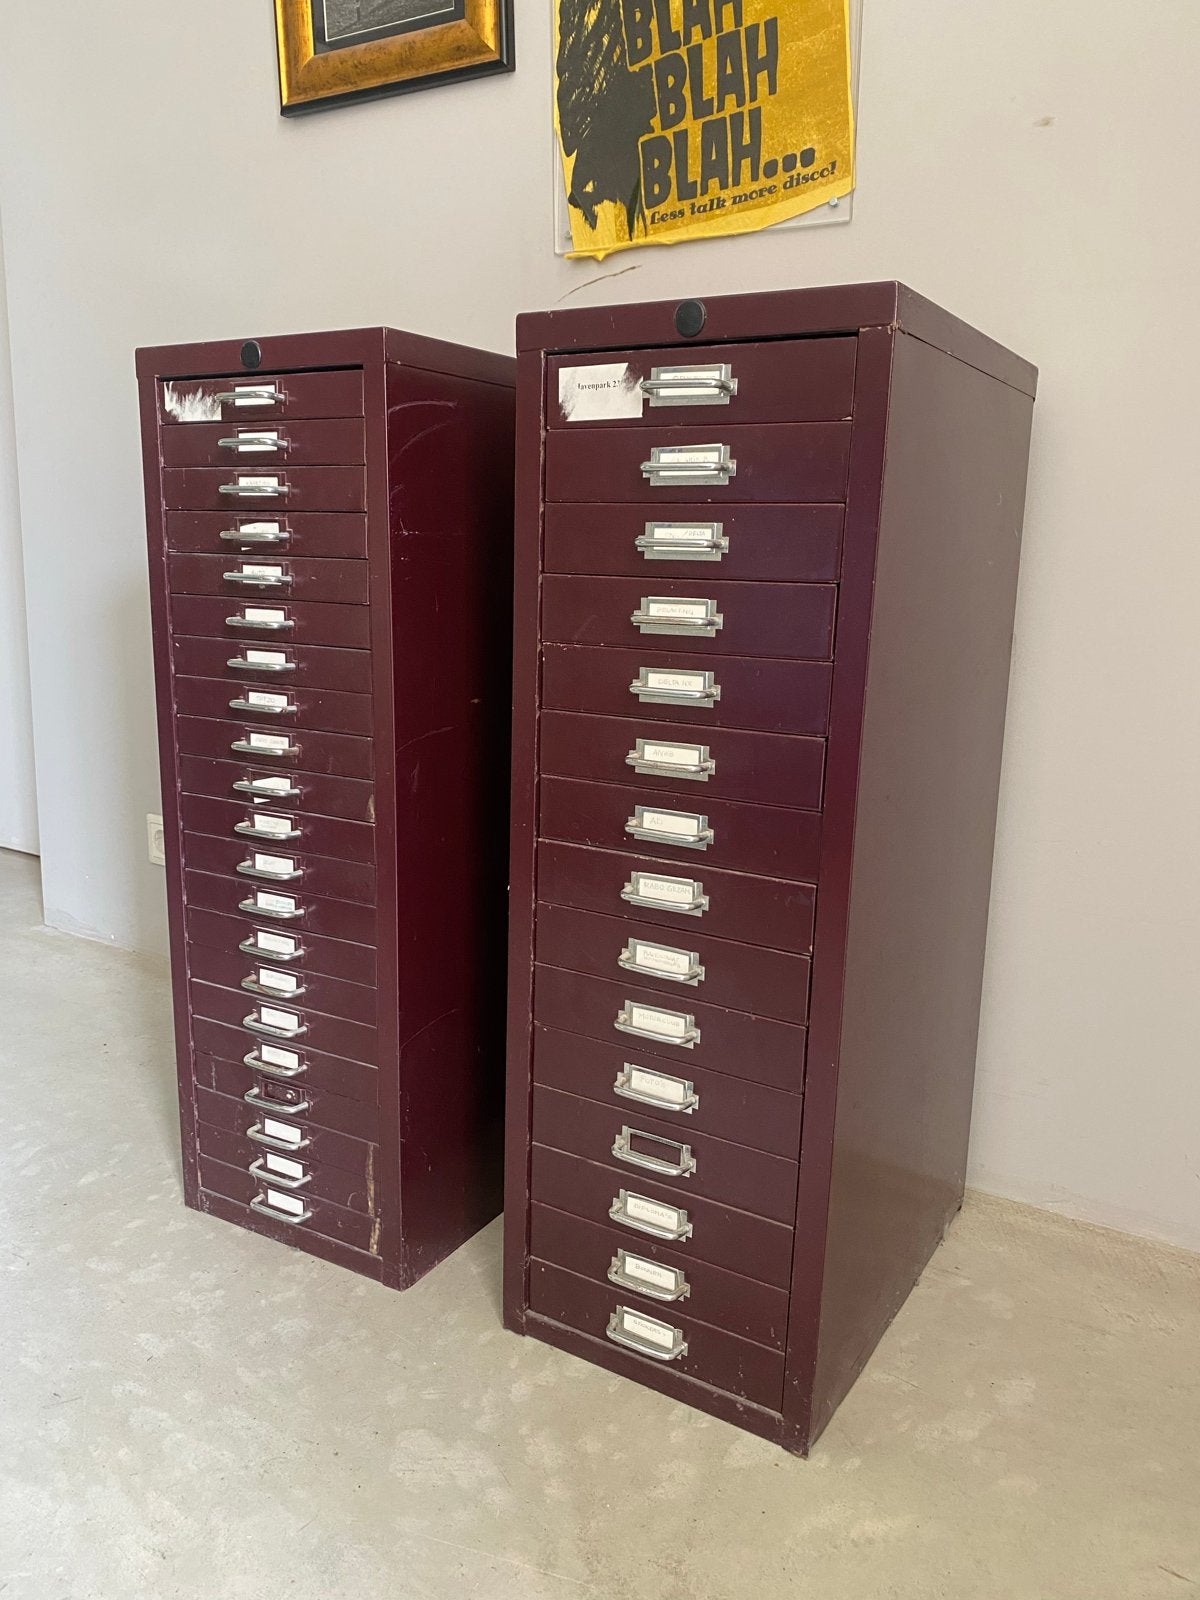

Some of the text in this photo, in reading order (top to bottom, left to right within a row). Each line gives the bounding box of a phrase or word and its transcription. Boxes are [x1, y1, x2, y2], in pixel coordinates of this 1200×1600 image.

[654, 16, 778, 131] BLAH
[641, 106, 816, 209] BLAH...
[650, 160, 837, 225] Less talk more disco!
